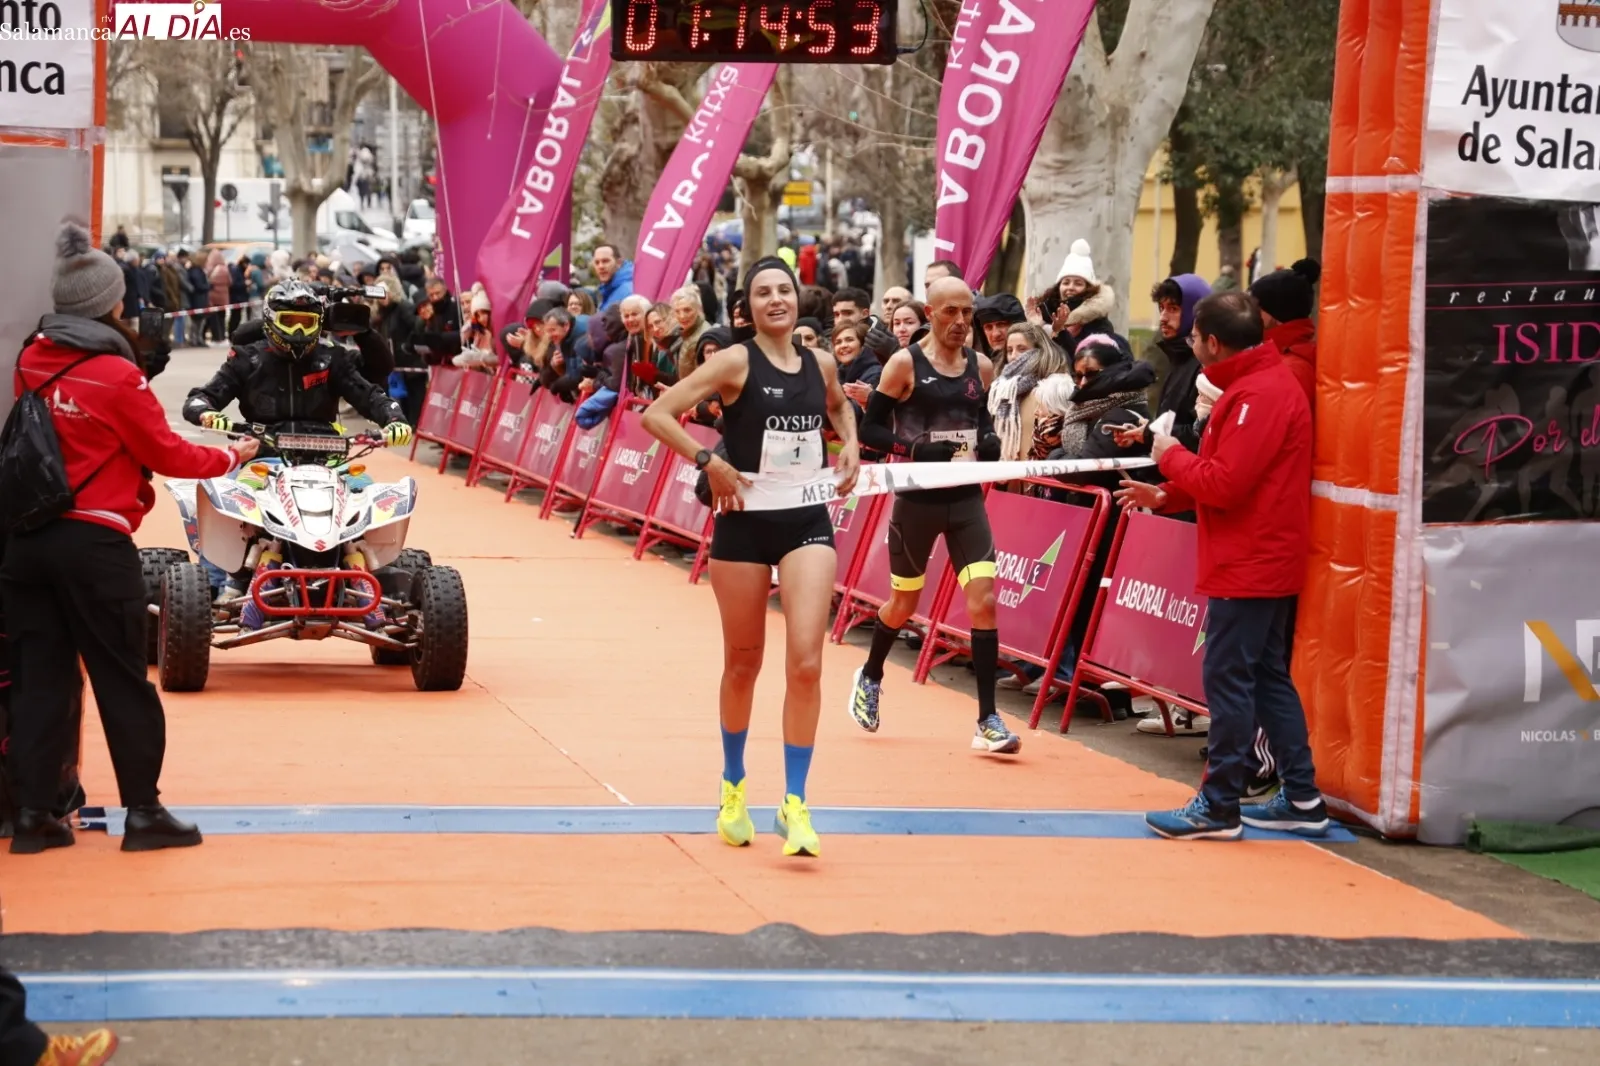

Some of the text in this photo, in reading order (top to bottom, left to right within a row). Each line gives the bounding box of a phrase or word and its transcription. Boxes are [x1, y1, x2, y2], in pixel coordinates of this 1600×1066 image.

[1461, 64, 1600, 118] Ayunta
[1457, 121, 1600, 171] de Sala
[765, 414, 823, 431] OYSHO
[793, 446, 801, 459] 1
[1115, 576, 1199, 628] LABORAL kutxa
[1520, 729, 1576, 742] NICOLAS
